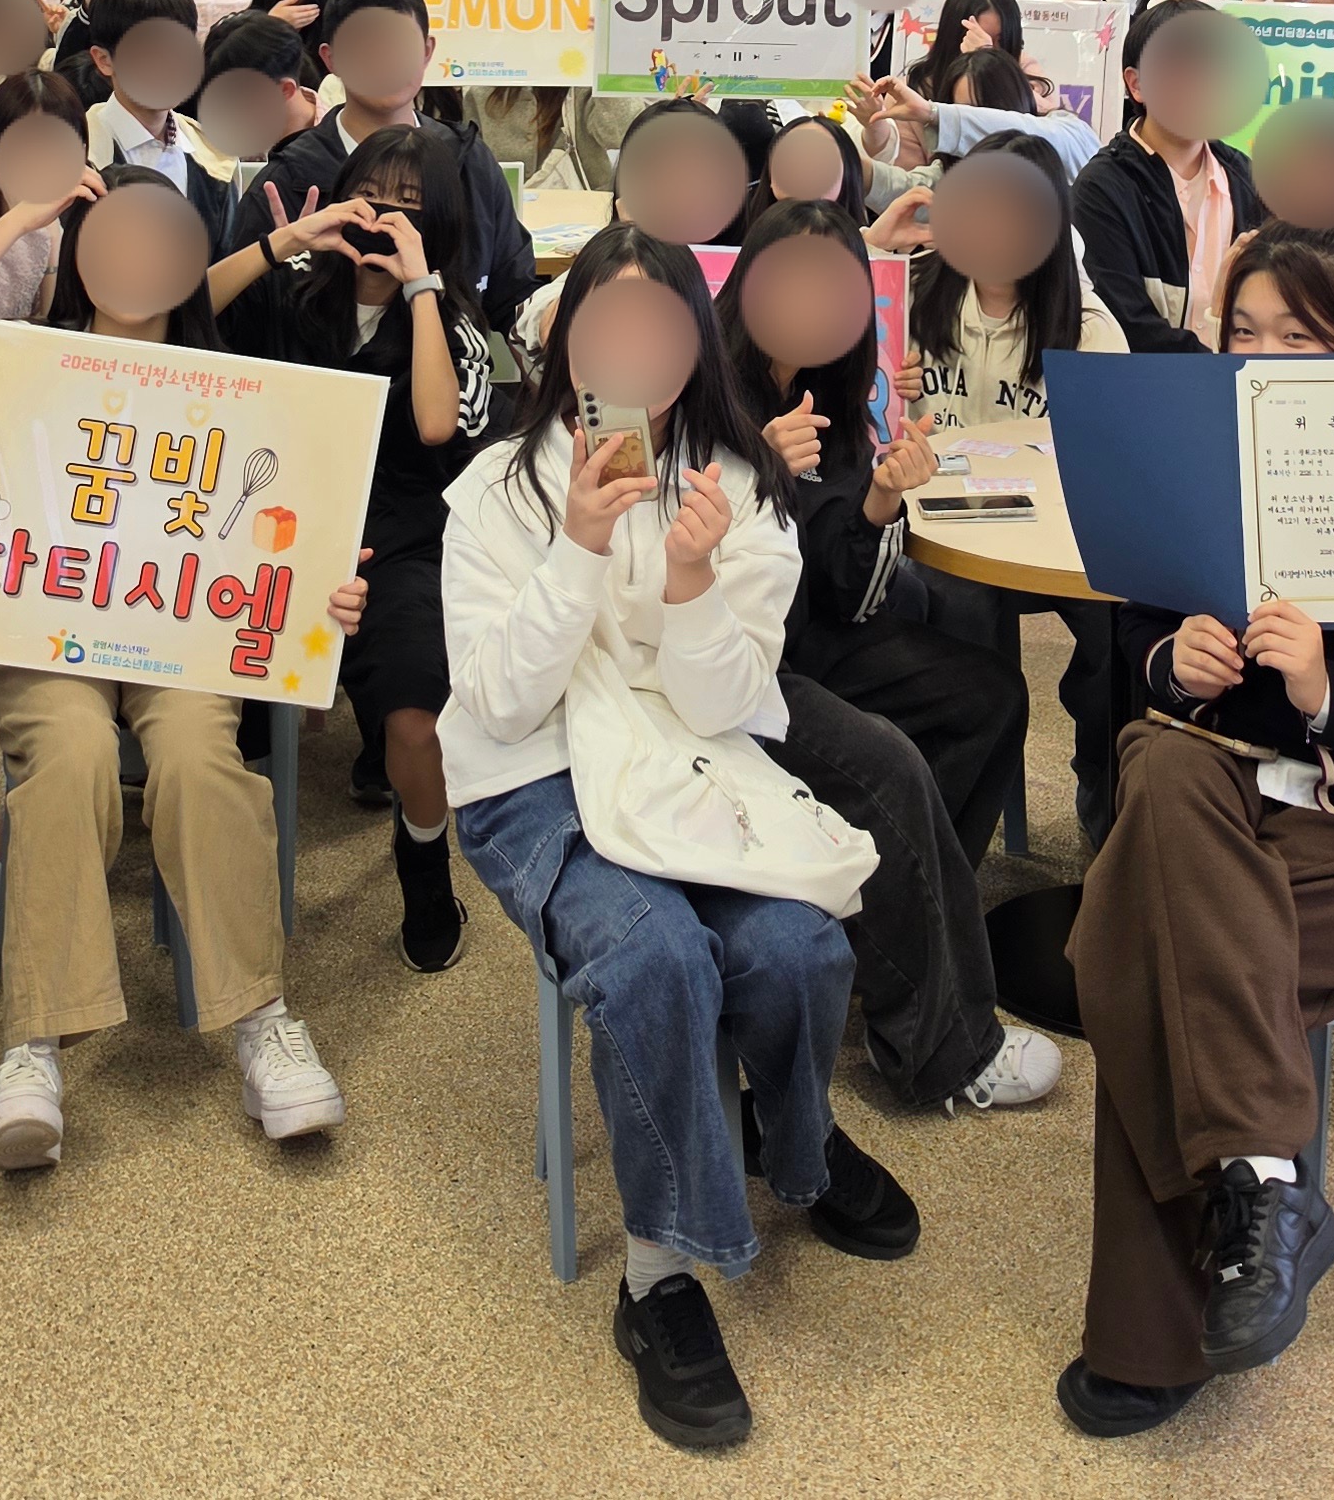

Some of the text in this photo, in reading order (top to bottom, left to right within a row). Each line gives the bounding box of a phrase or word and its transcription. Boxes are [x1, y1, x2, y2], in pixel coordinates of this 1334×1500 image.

[1020, 9, 1069, 22] 년활동센터
[61, 353, 263, 400] 2026년 디딤청소년활동센터
[65, 416, 226, 539] 꿈빛
[92, 639, 151, 656] 광명시청소년재단
[91, 652, 184, 676] 디딤청소년활동센터
